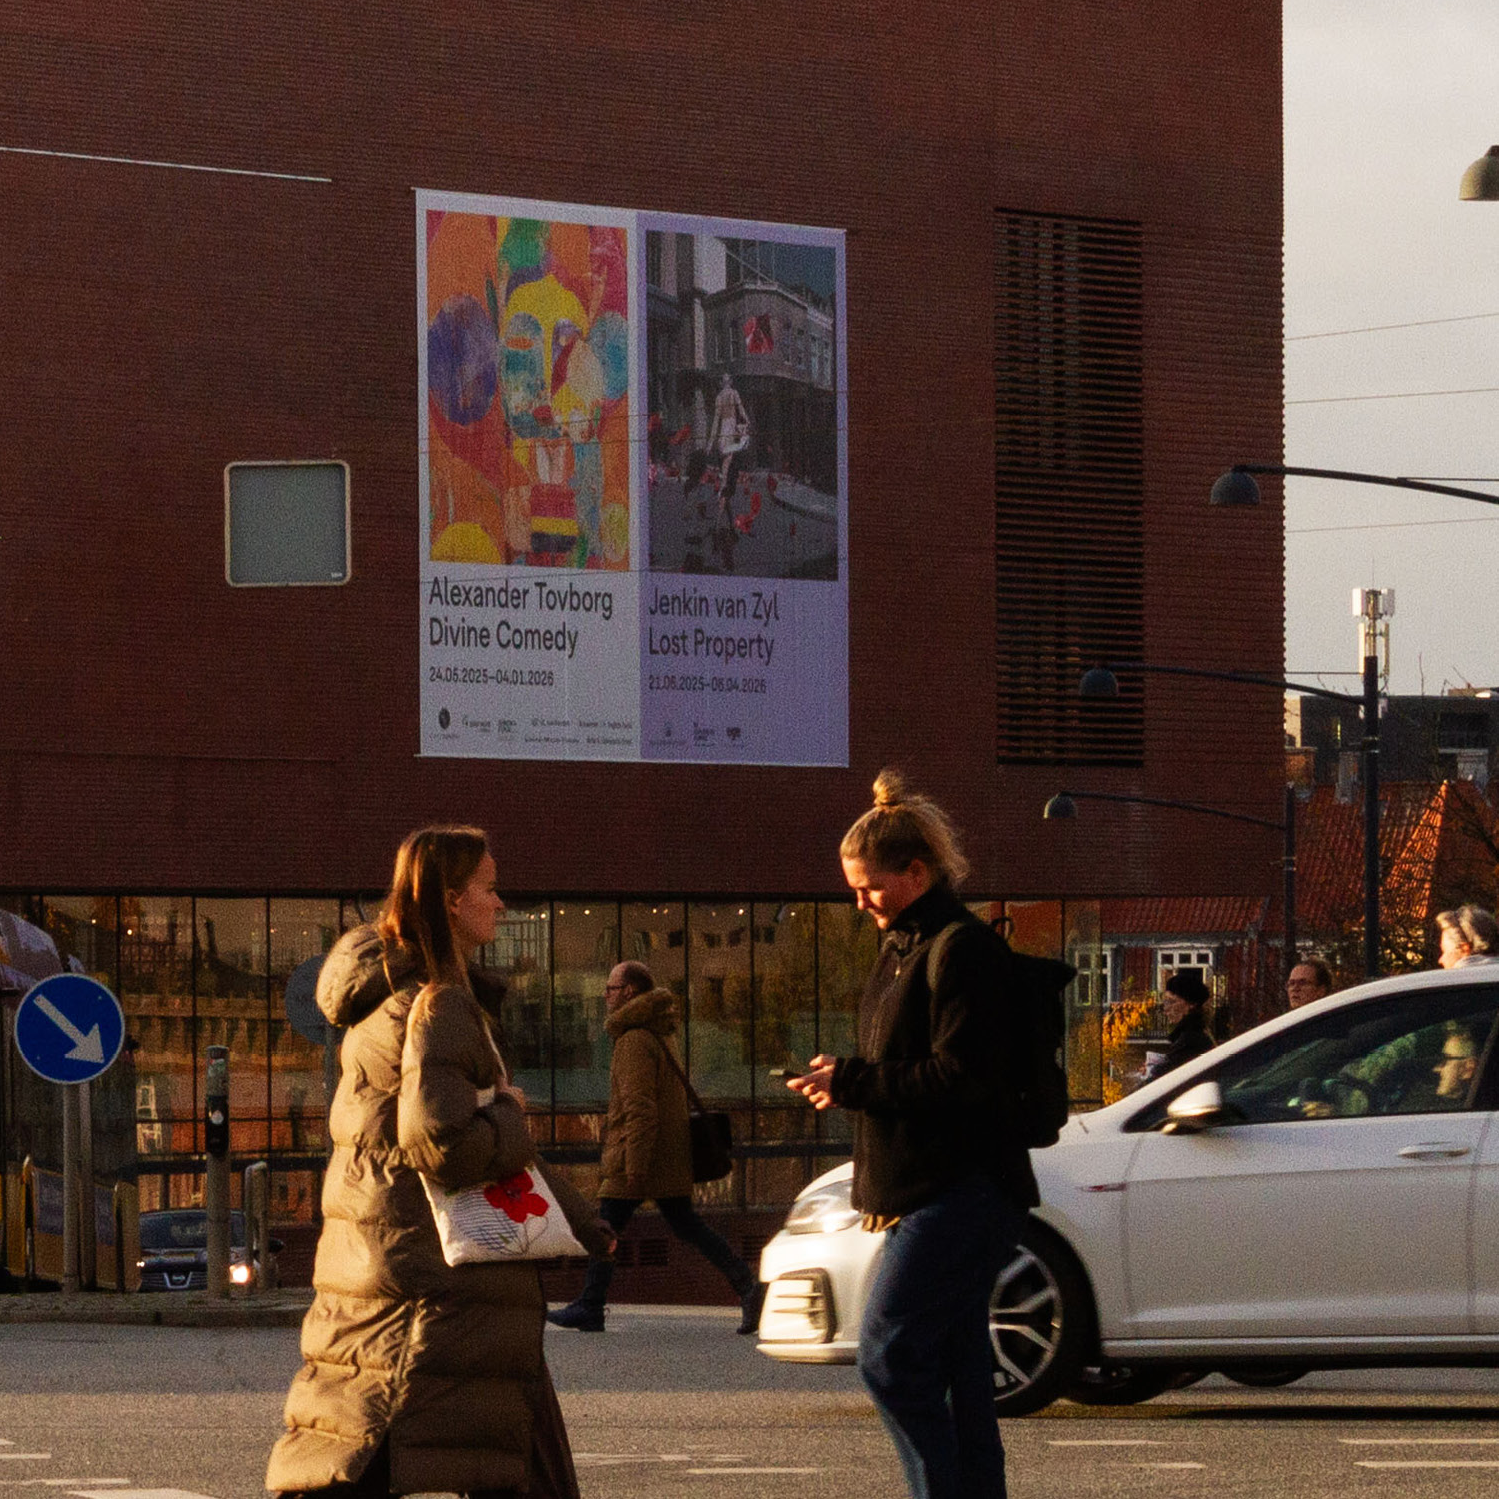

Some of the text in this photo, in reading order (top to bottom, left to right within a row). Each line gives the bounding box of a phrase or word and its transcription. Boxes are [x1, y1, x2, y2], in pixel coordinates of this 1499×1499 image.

[429, 576, 613, 620] Alexander Tovborg
[648, 586, 780, 627] Jenkin van Zyl
[429, 616, 579, 659] Divine Comedy
[648, 626, 775, 666] Lost Property
